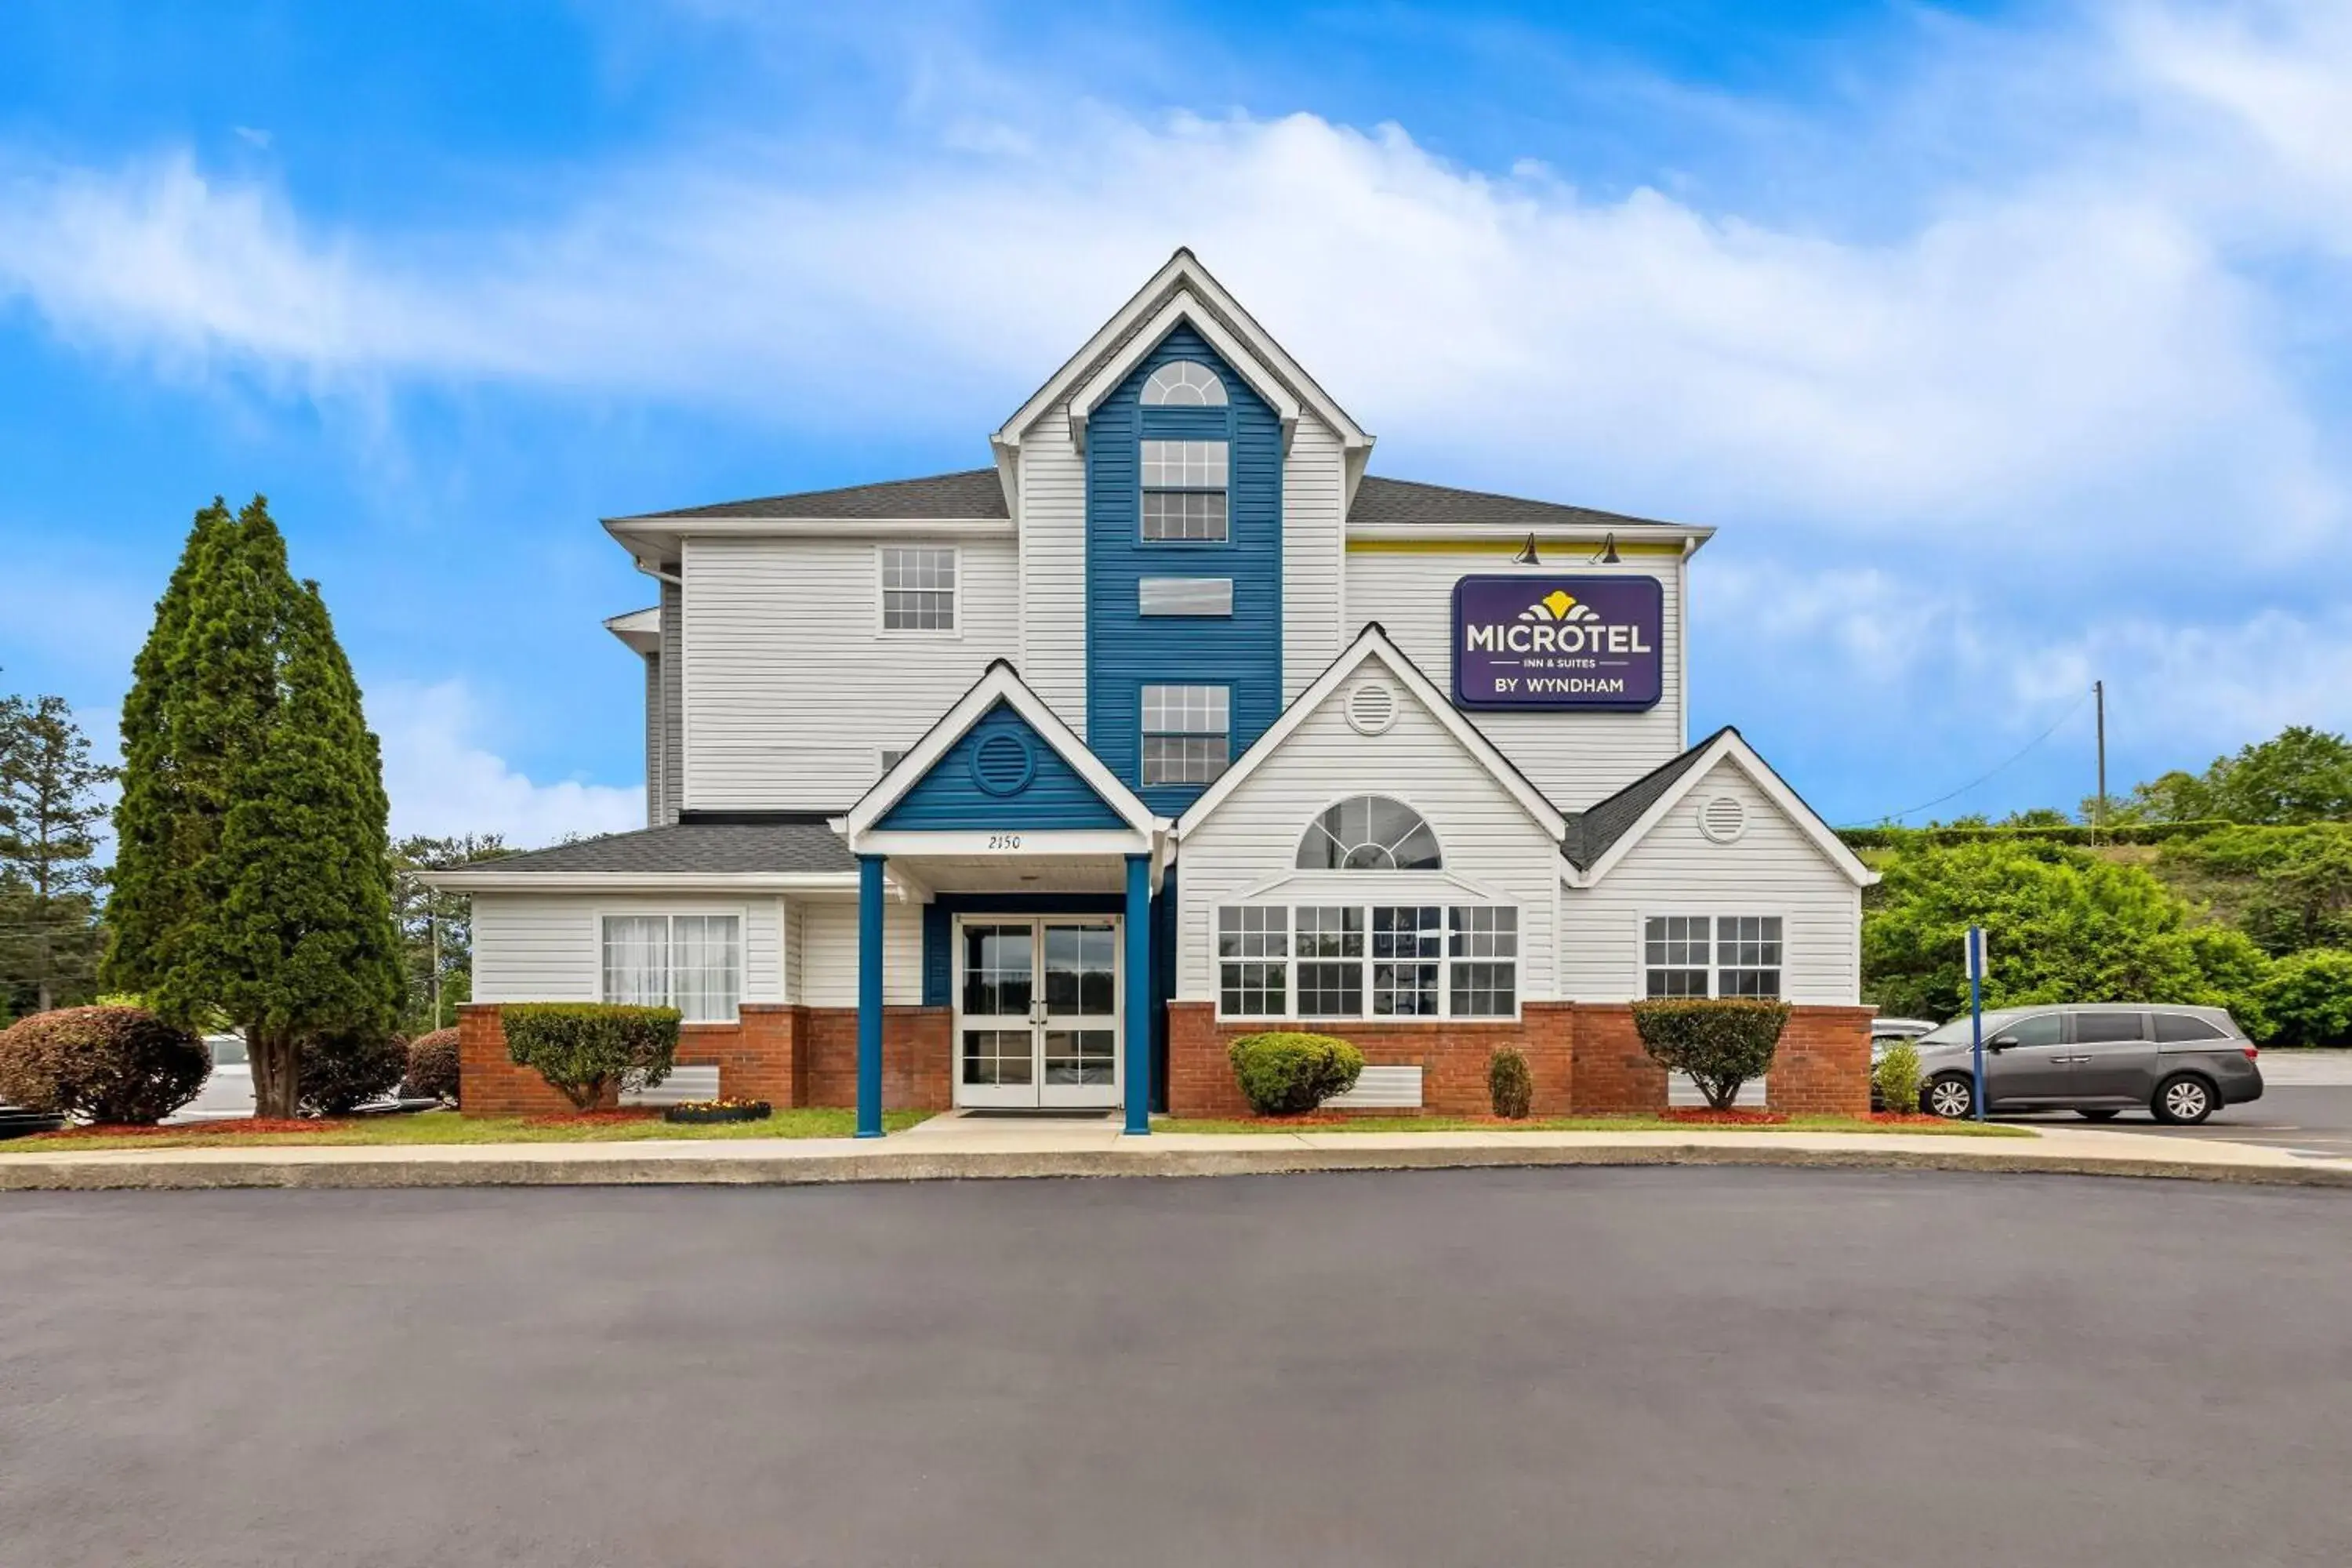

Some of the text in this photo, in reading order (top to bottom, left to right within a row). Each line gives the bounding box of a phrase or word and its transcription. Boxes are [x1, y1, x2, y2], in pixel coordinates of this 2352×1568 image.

[1467, 625, 1651, 652] MICROTEL
[1524, 659, 1596, 669] INN & SUITES
[1495, 678, 1624, 692] BY WYNDHAM
[989, 836, 1021, 849] 2150
